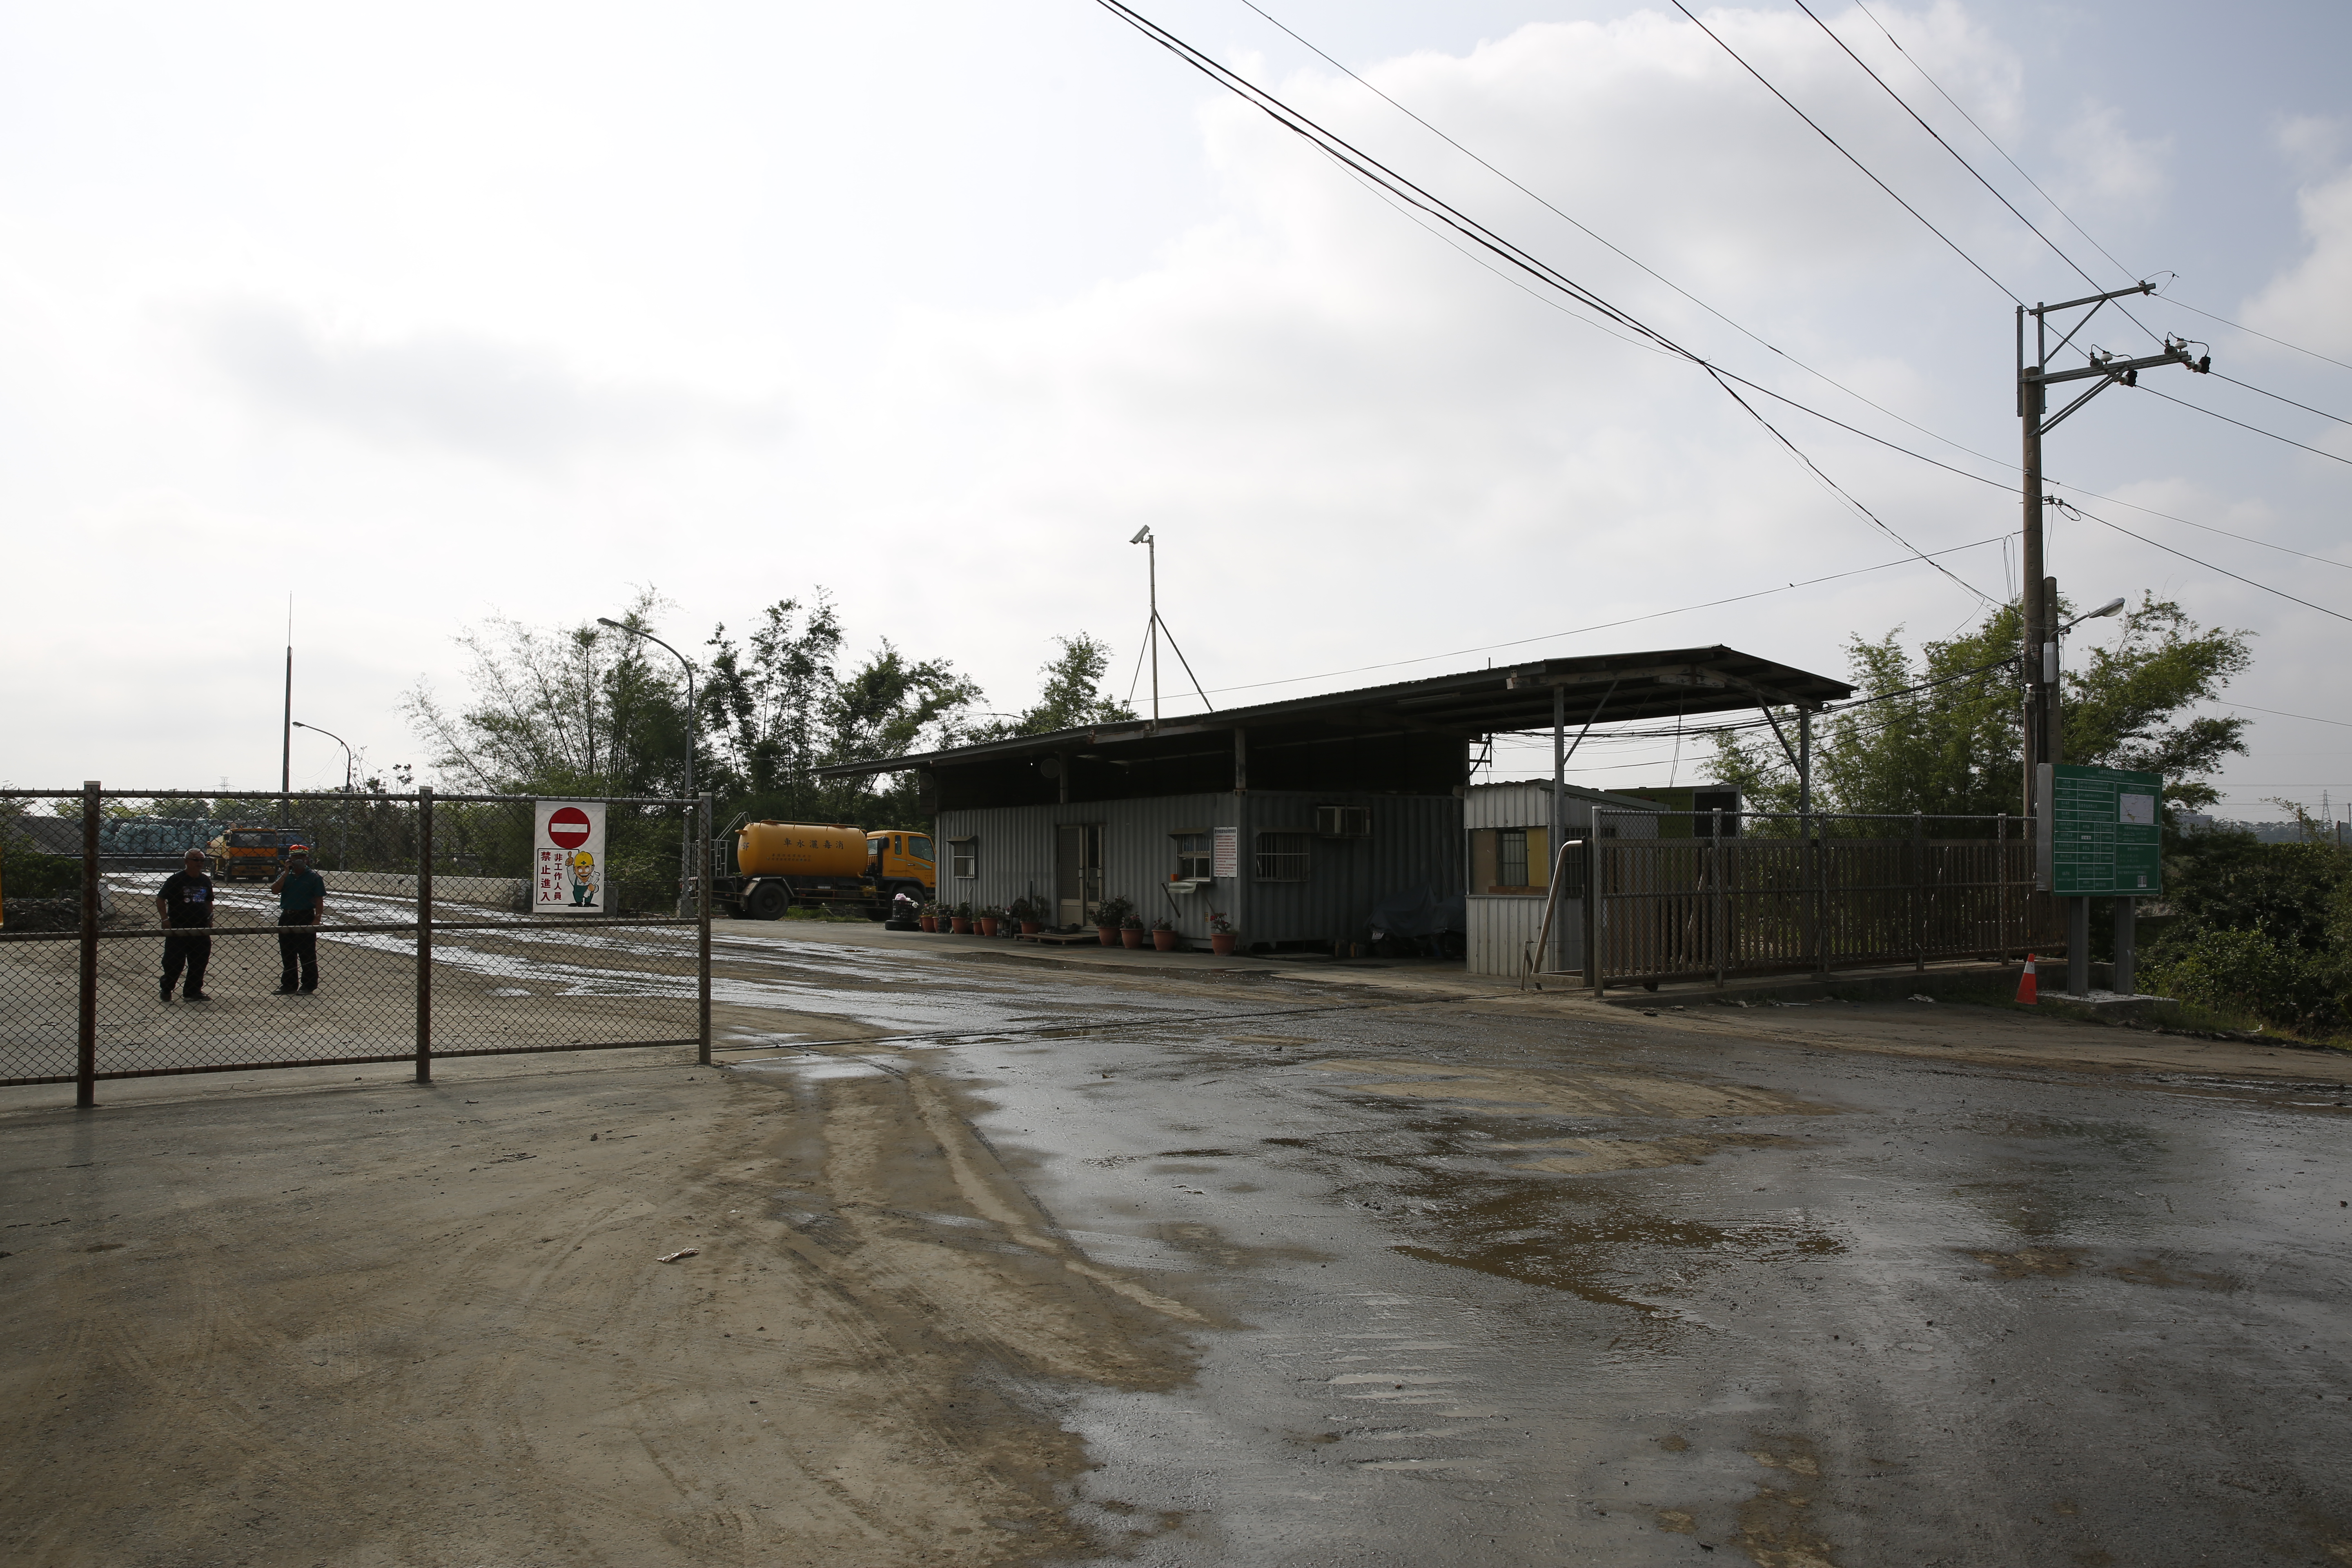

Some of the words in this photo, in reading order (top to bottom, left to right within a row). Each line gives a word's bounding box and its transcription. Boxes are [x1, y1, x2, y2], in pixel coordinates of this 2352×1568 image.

[541, 851, 551, 902] 禁止進入
[554, 853, 563, 900] 非工作人員
